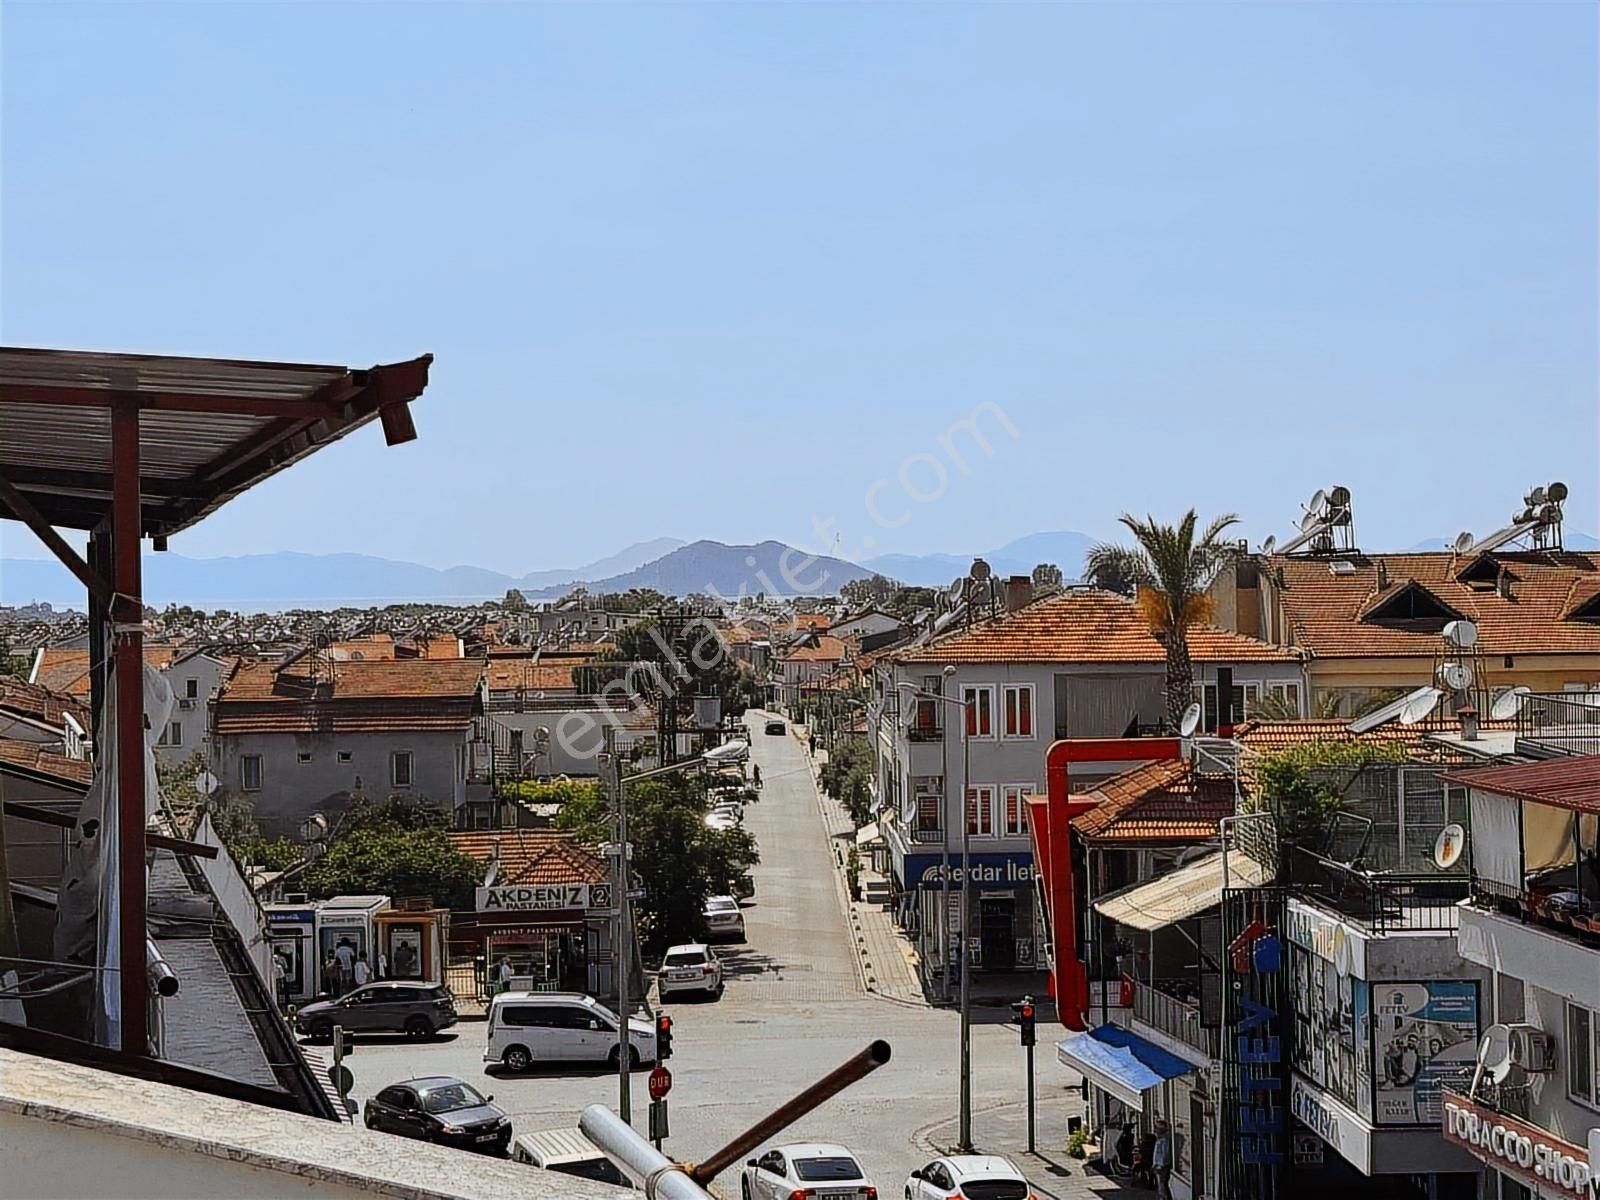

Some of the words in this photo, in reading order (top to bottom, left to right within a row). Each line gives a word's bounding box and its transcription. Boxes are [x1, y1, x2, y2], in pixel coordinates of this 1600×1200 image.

[595, 889, 605, 903] 2
[650, 1075, 670, 1088] DUR
[1445, 1102, 1533, 1168] TOBACCO
[1534, 1143, 1590, 1194] SHOP
